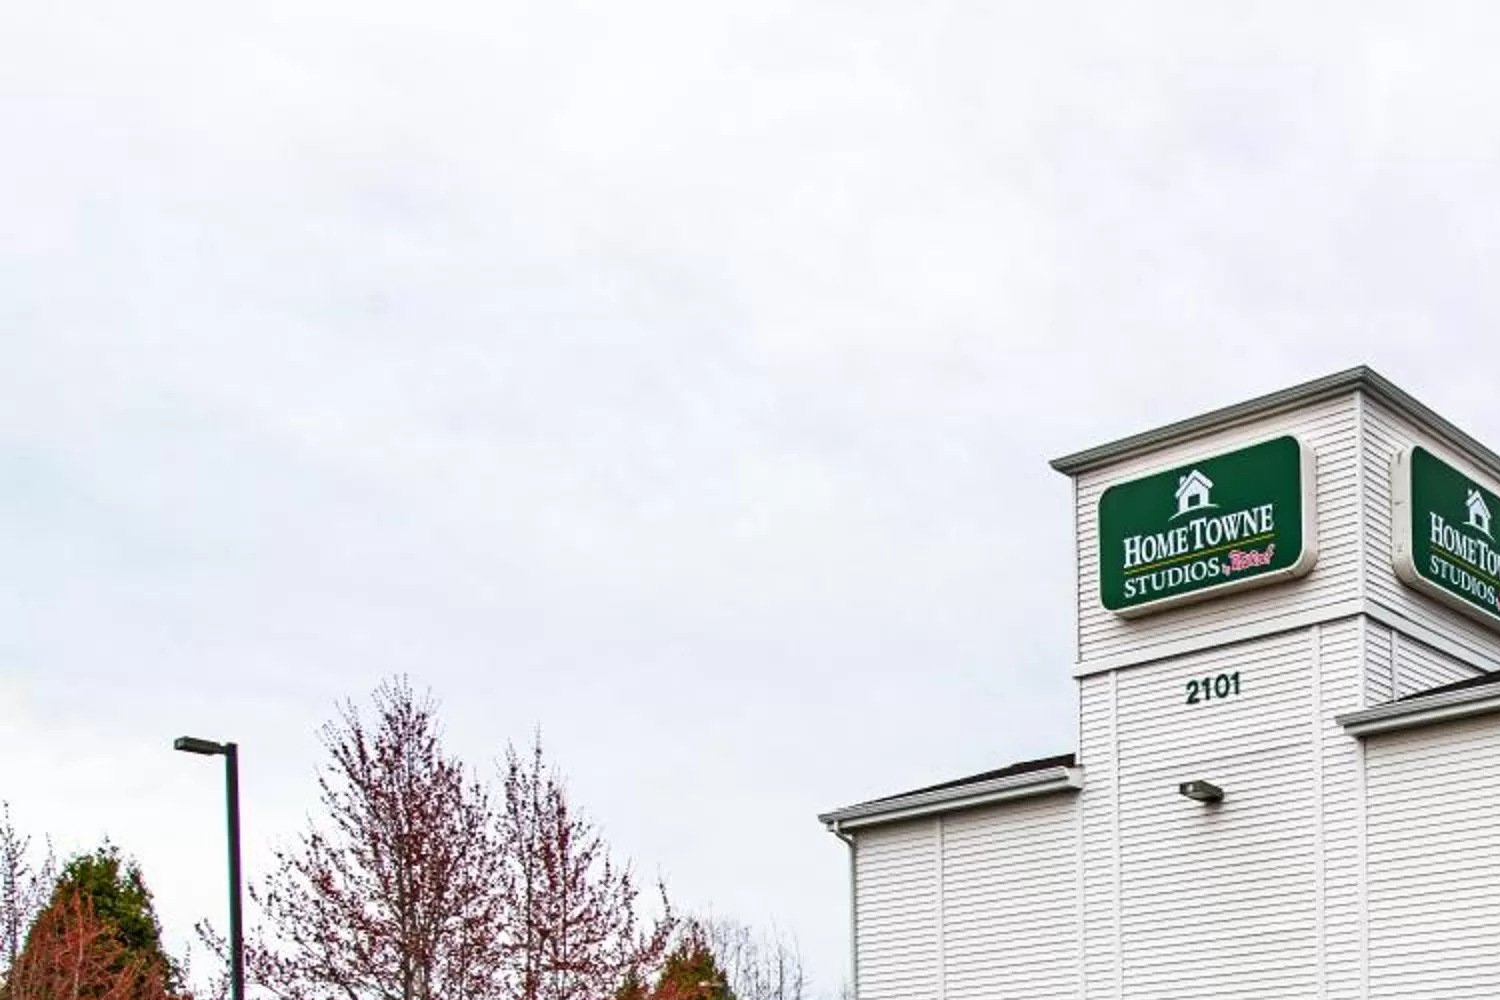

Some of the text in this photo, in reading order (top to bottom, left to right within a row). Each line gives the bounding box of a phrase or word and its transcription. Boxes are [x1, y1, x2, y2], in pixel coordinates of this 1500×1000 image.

[1123, 557, 1220, 599] STUDIOS
[1429, 555, 1495, 605] STUDIOS
[1186, 671, 1240, 704] 2101
